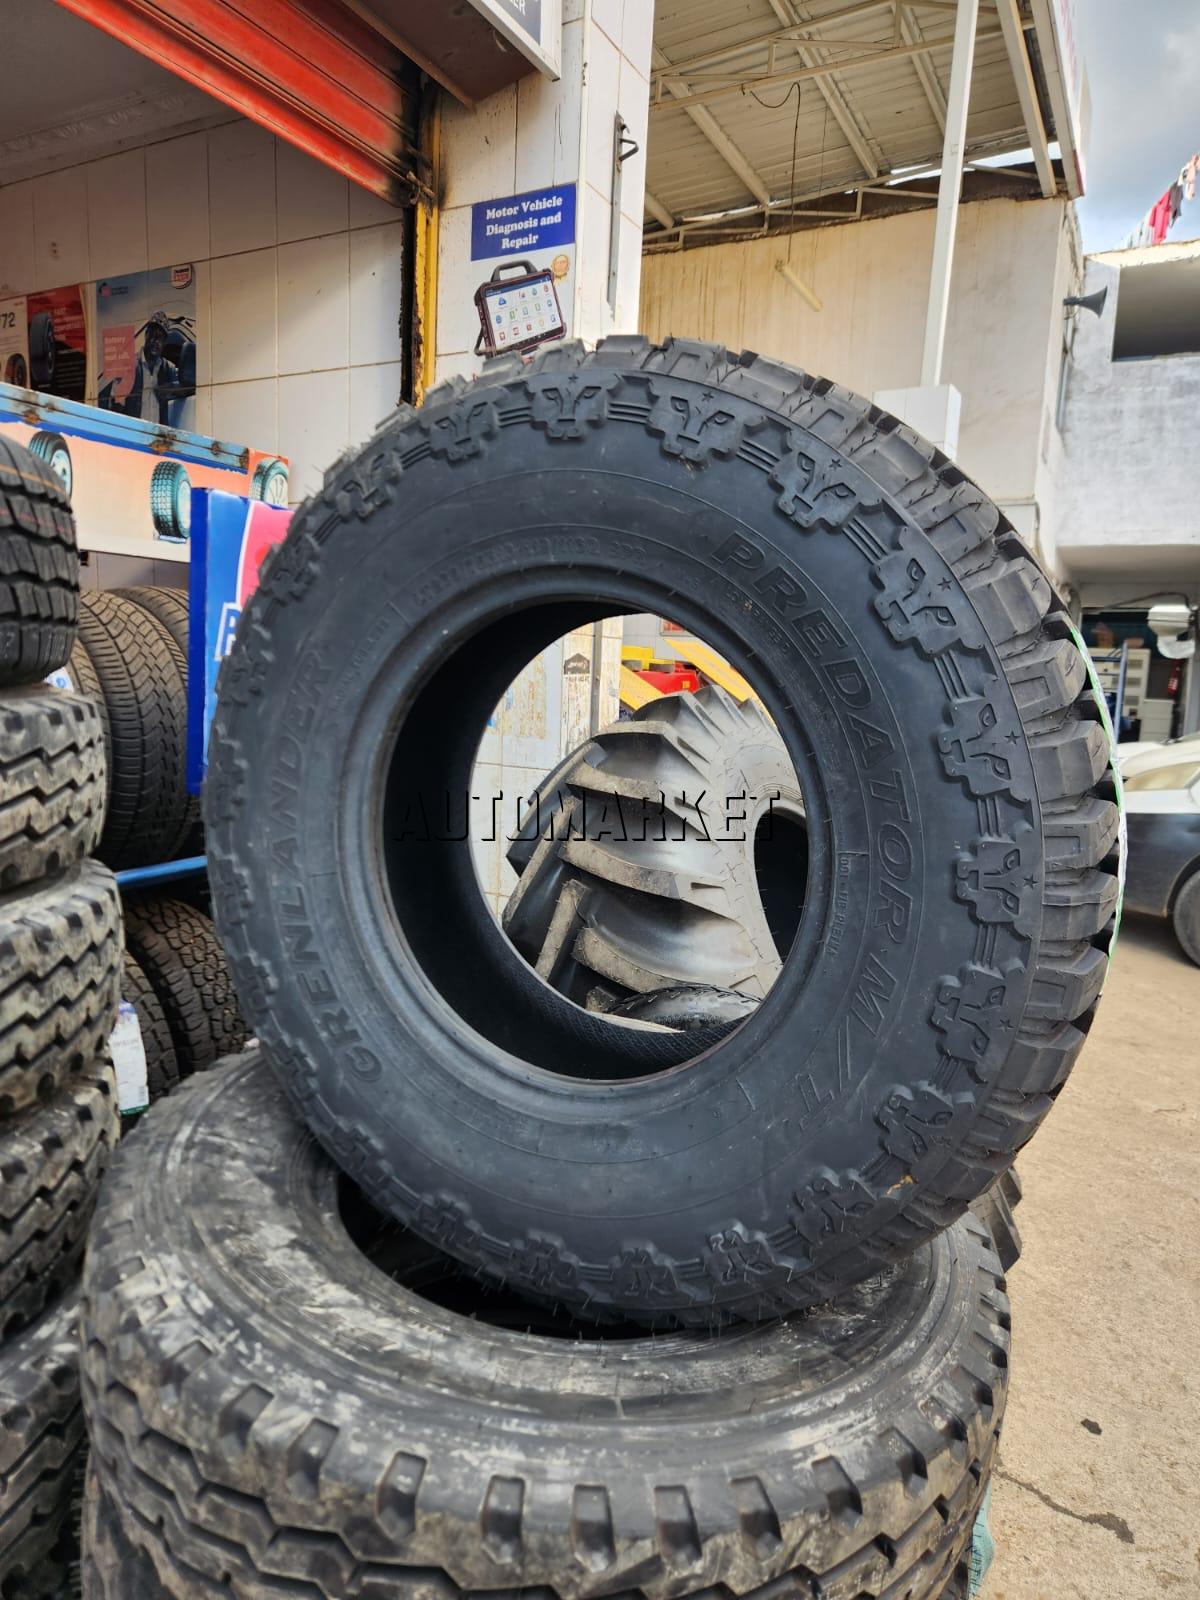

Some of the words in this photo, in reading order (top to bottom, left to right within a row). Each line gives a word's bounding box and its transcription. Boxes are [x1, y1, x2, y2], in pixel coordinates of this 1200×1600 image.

[486, 204, 520, 221] Motor
[521, 195, 563, 213] Vehicle
[486, 217, 538, 236] Diagnosis
[540, 212, 562, 226] and
[501, 233, 539, 250] Repair
[711, 531, 915, 945] PREDATOR
[268, 647, 383, 1083] GRENLANDER
